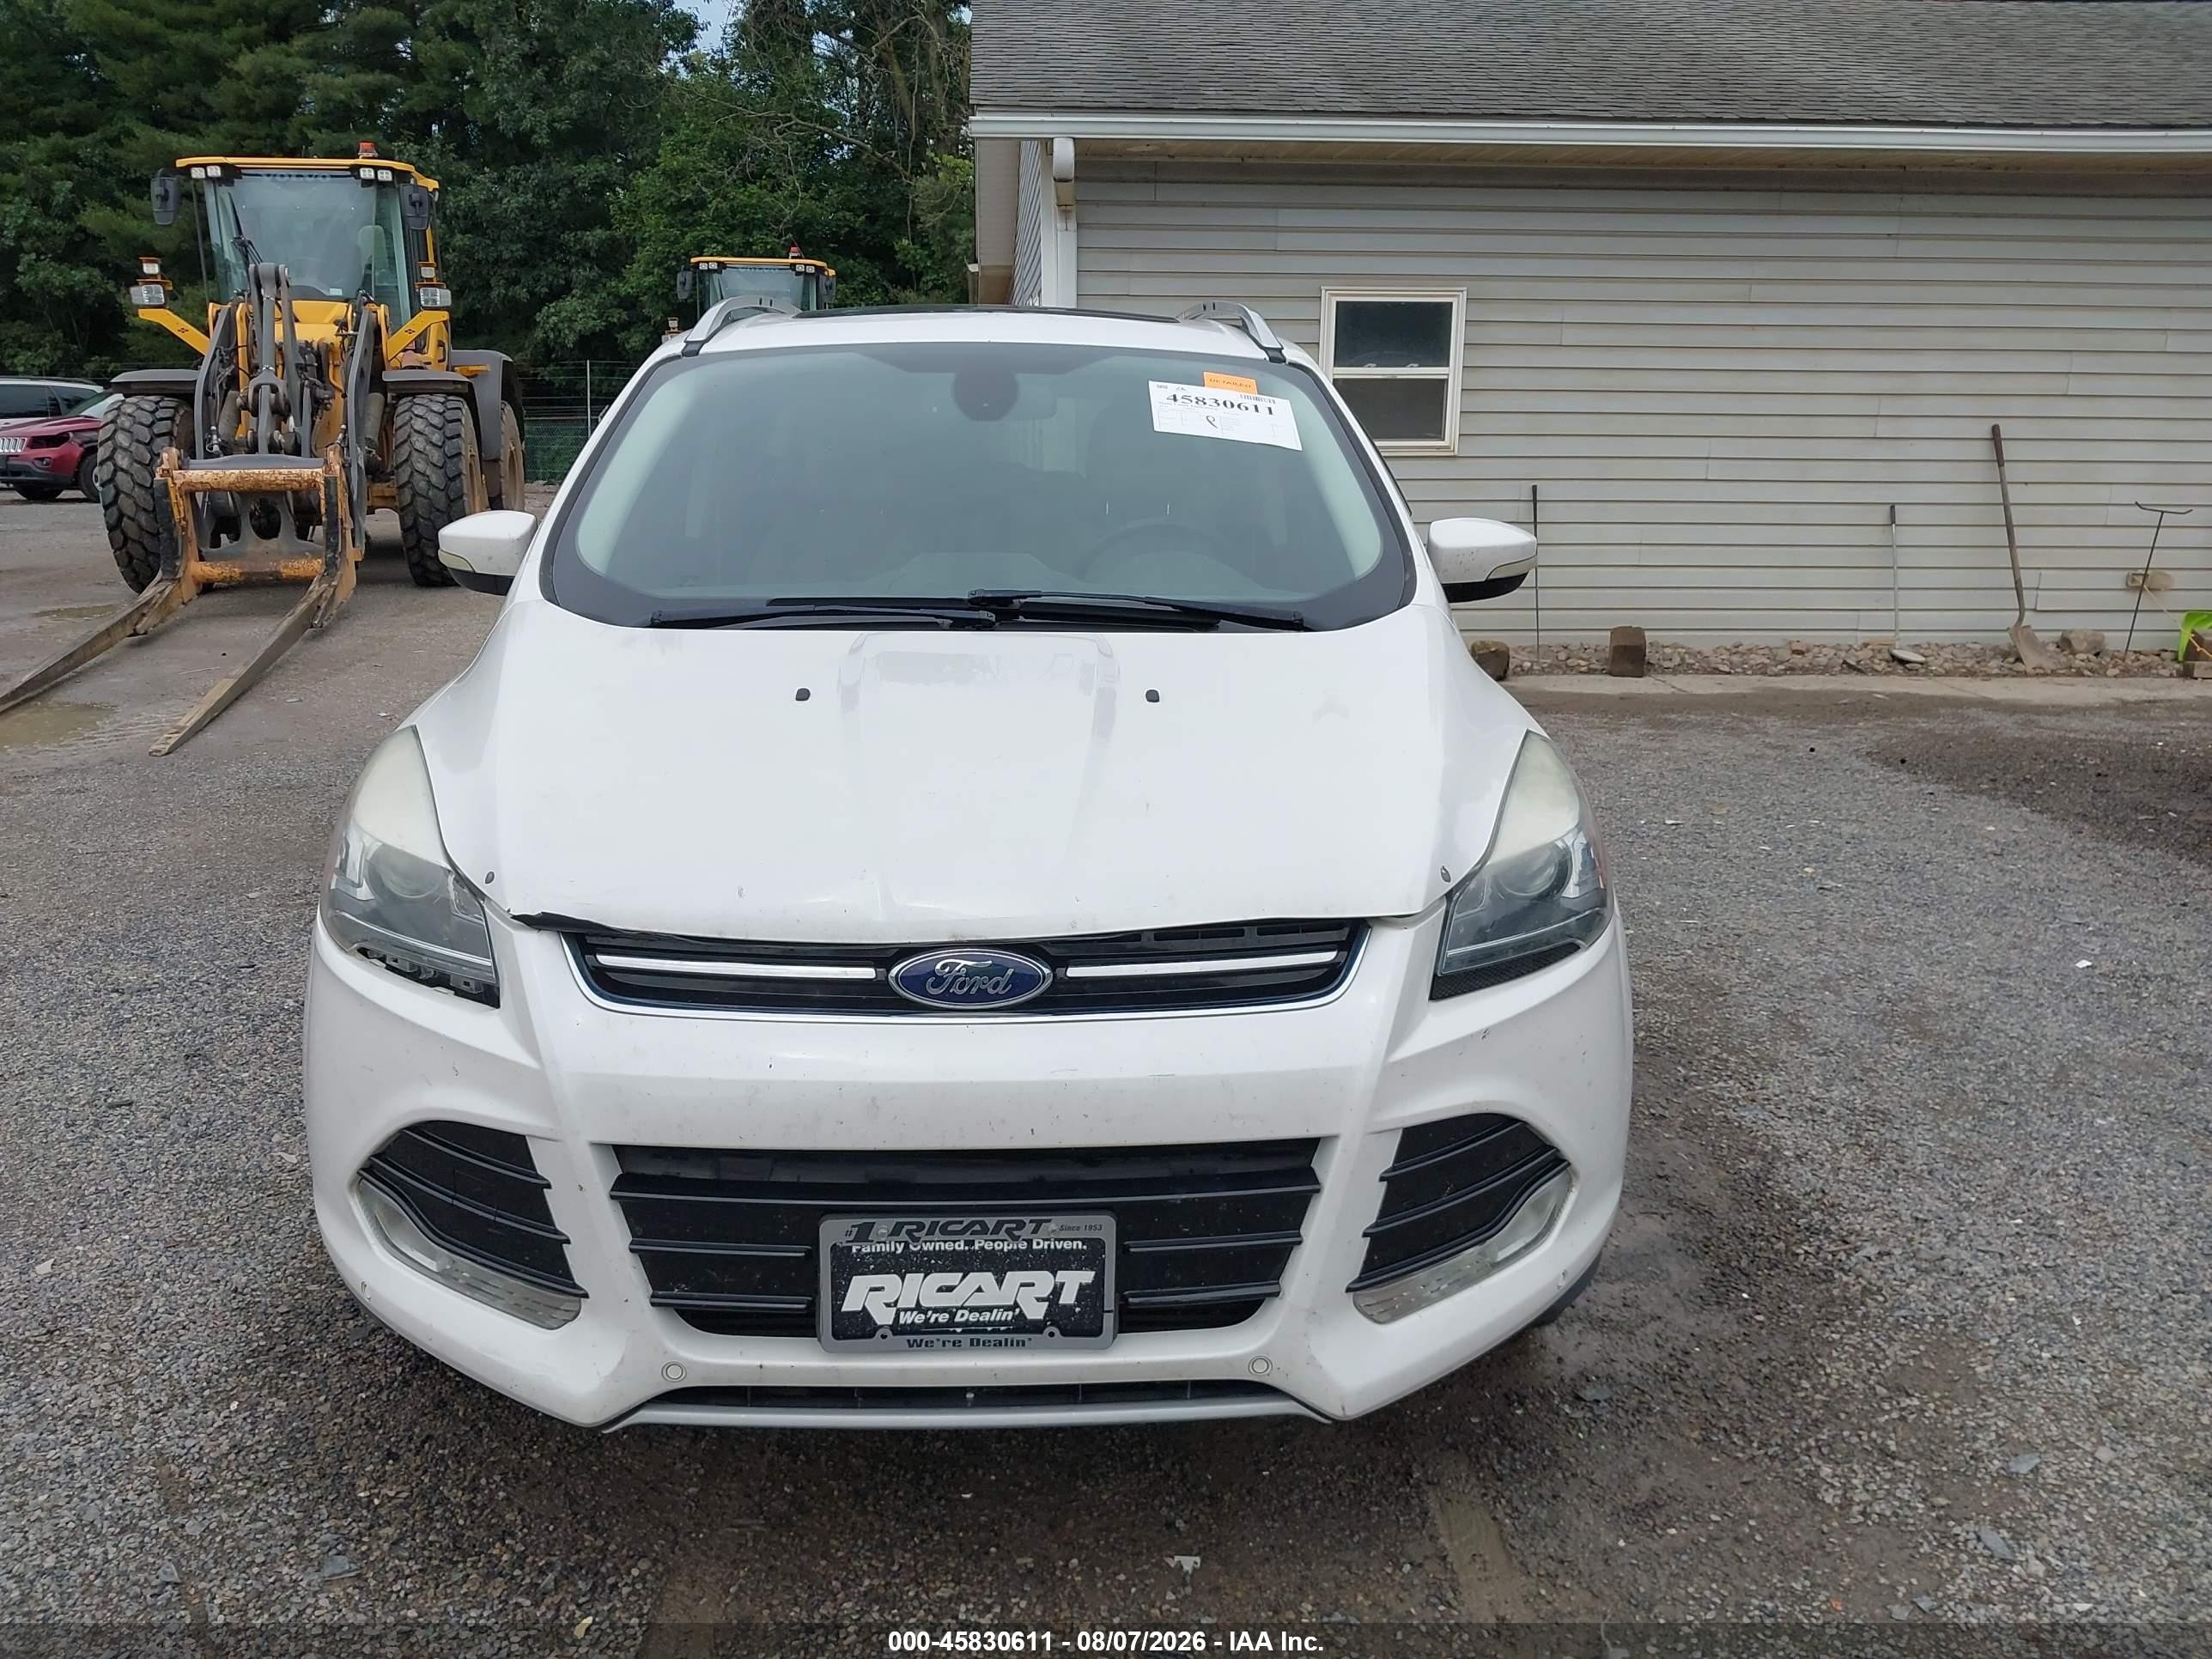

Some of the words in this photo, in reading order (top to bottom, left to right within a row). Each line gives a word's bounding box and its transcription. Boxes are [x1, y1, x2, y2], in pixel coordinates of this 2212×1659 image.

[1166, 393, 1274, 416] 45830611
[926, 958, 1015, 995] Ford
[887, 1218, 1053, 1243] RICART
[851, 1240, 905, 1254] Family
[974, 1239, 1028, 1252] People
[1032, 1237, 1088, 1250] Driven.
[841, 1270, 1097, 1326] RICART
[899, 1310, 949, 1325] We're
[954, 1308, 1020, 1322] Dealin'
[907, 1338, 963, 1348] We're
[969, 1337, 1032, 1347] Dealin'
